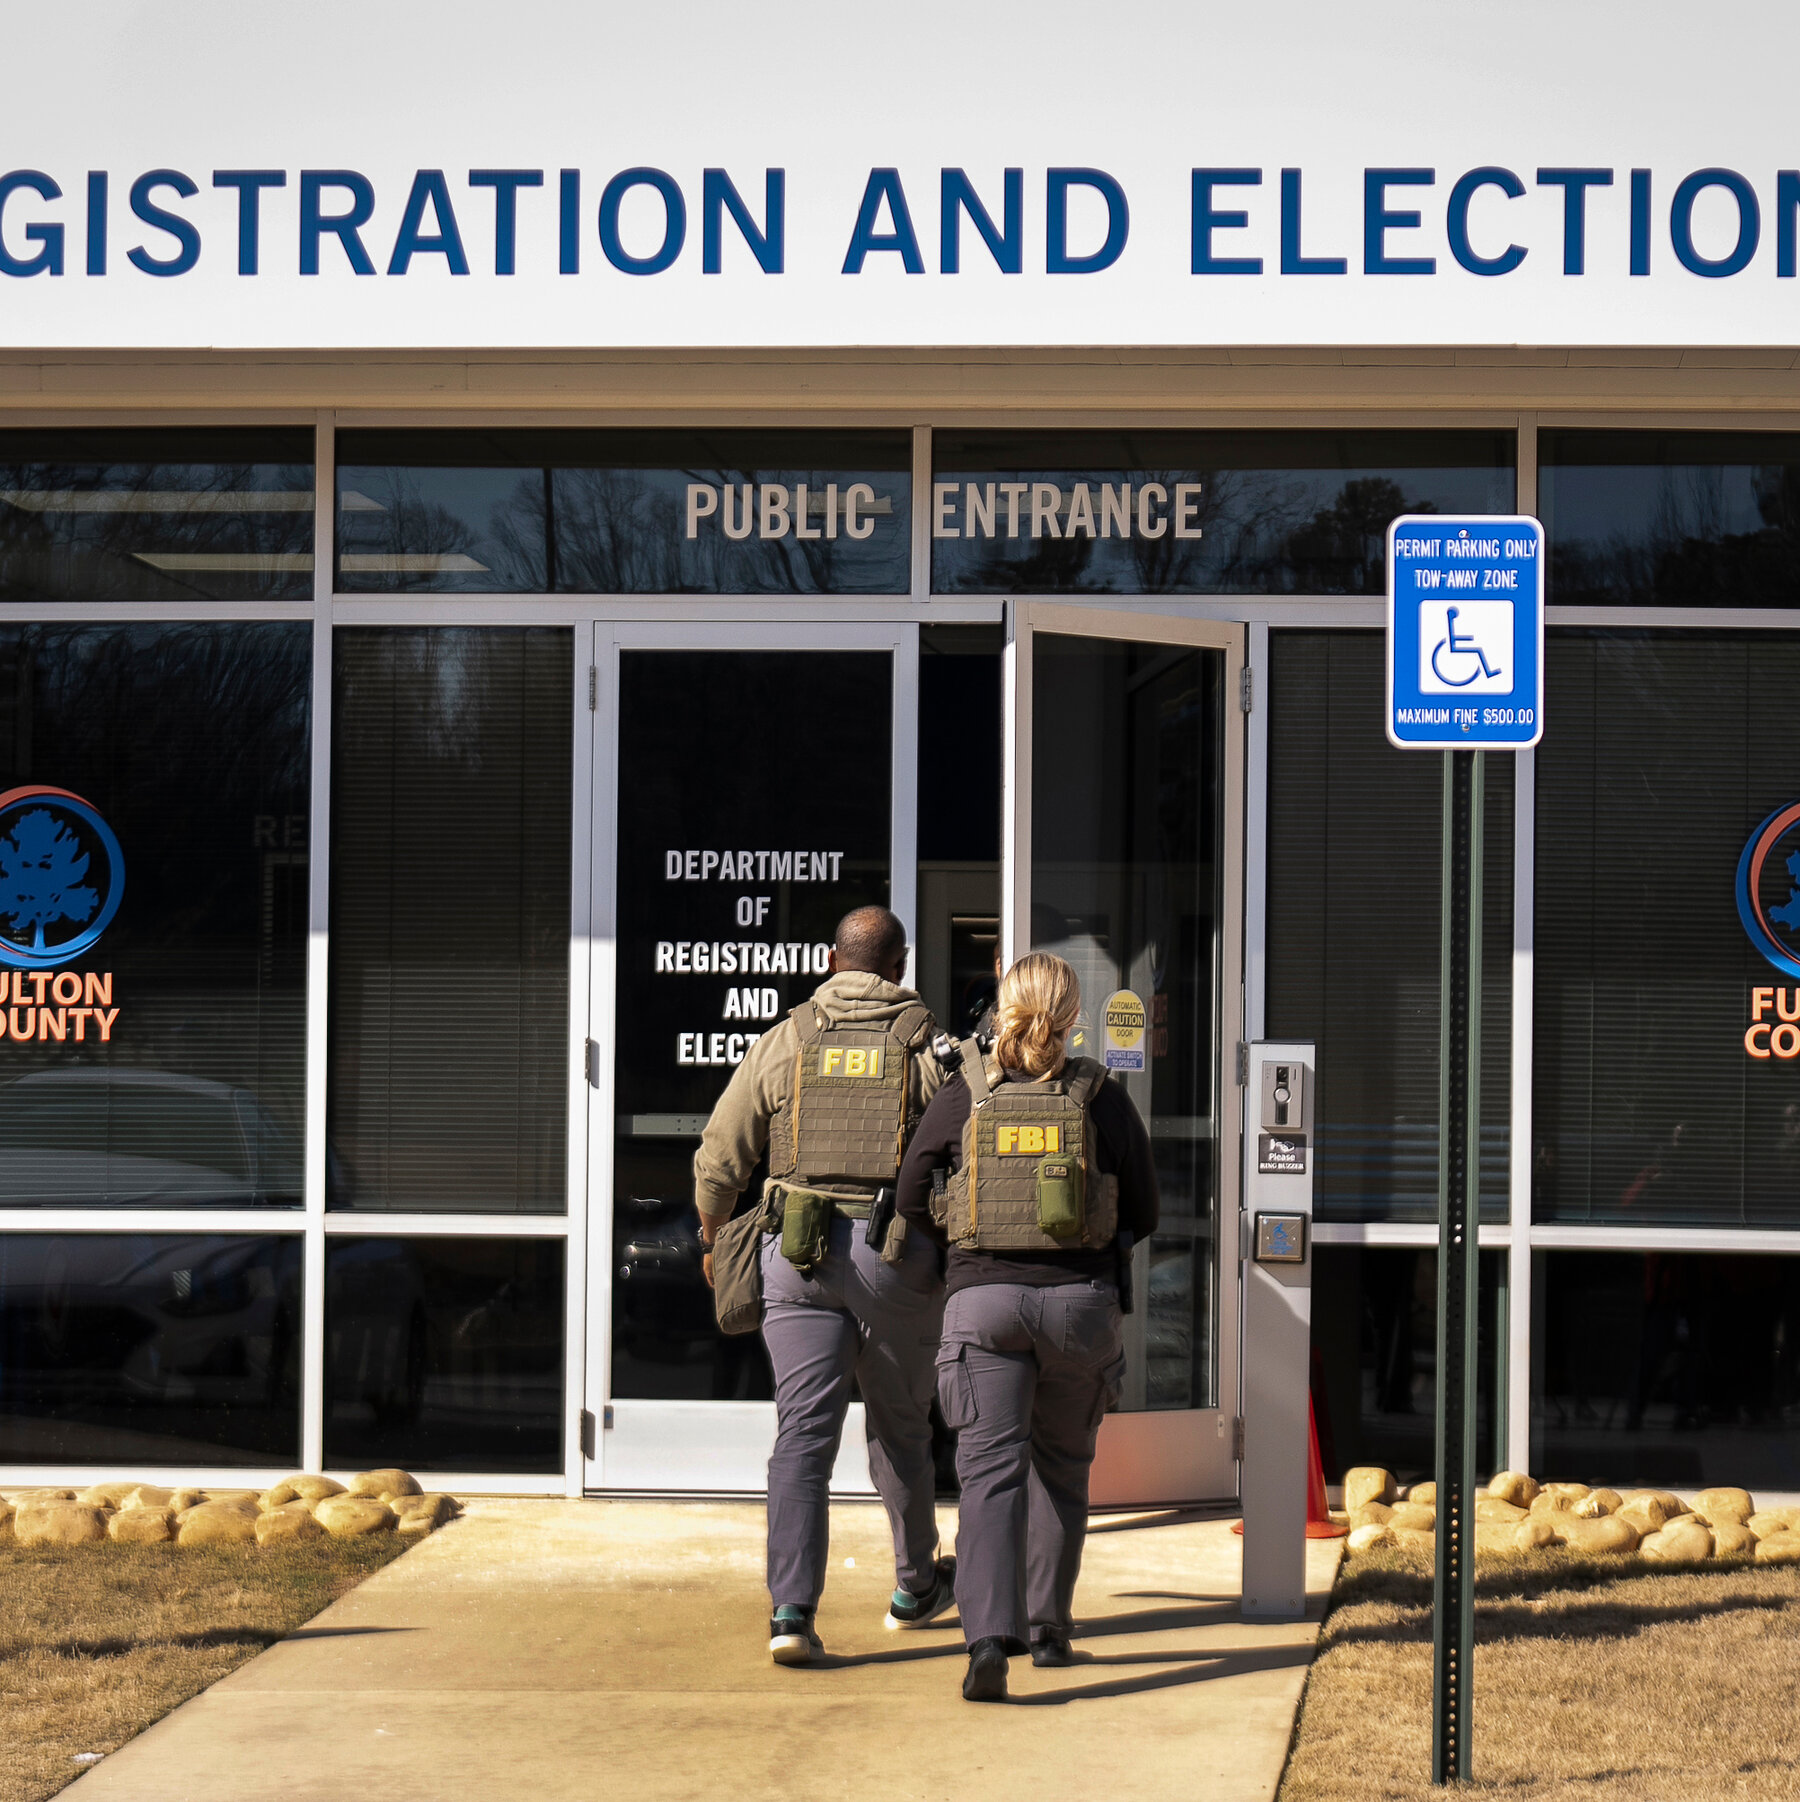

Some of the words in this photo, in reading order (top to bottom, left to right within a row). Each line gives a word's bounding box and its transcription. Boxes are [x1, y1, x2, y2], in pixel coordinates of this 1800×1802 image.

[0, 167, 786, 277] GISTRATION
[841, 167, 1130, 275] AND
[1191, 166, 1800, 277] ELECTION
[685, 482, 877, 540] PUBLIC
[932, 481, 1203, 540] ENTRANCE
[1395, 538, 1441, 558] PERMIT
[1446, 539, 1500, 559] PARKING
[1504, 539, 1538, 558] ONLY
[1414, 569, 1479, 588] TOW-AWAY
[1483, 569, 1519, 589] ZONE
[1397, 708, 1450, 724] MAXIMUM
[1454, 708, 1479, 725] FINE
[1483, 707, 1535, 725] $500.00
[665, 850, 844, 881] DEPARTMENT
[736, 896, 771, 926] OF
[655, 941, 837, 974] REGISTRATIO
[722, 988, 779, 1020] AND
[1110, 1001, 1141, 1010] AUTOMATIC
[0, 1007, 120, 1041] UNTY
[1107, 1013, 1143, 1026] CAUTION
[1116, 1028, 1134, 1037] DOOR
[1744, 1023, 1800, 1058] CO
[823, 1048, 879, 1076] FBI
[997, 1125, 1060, 1153] FBI
[1268, 1152, 1296, 1162] Please
